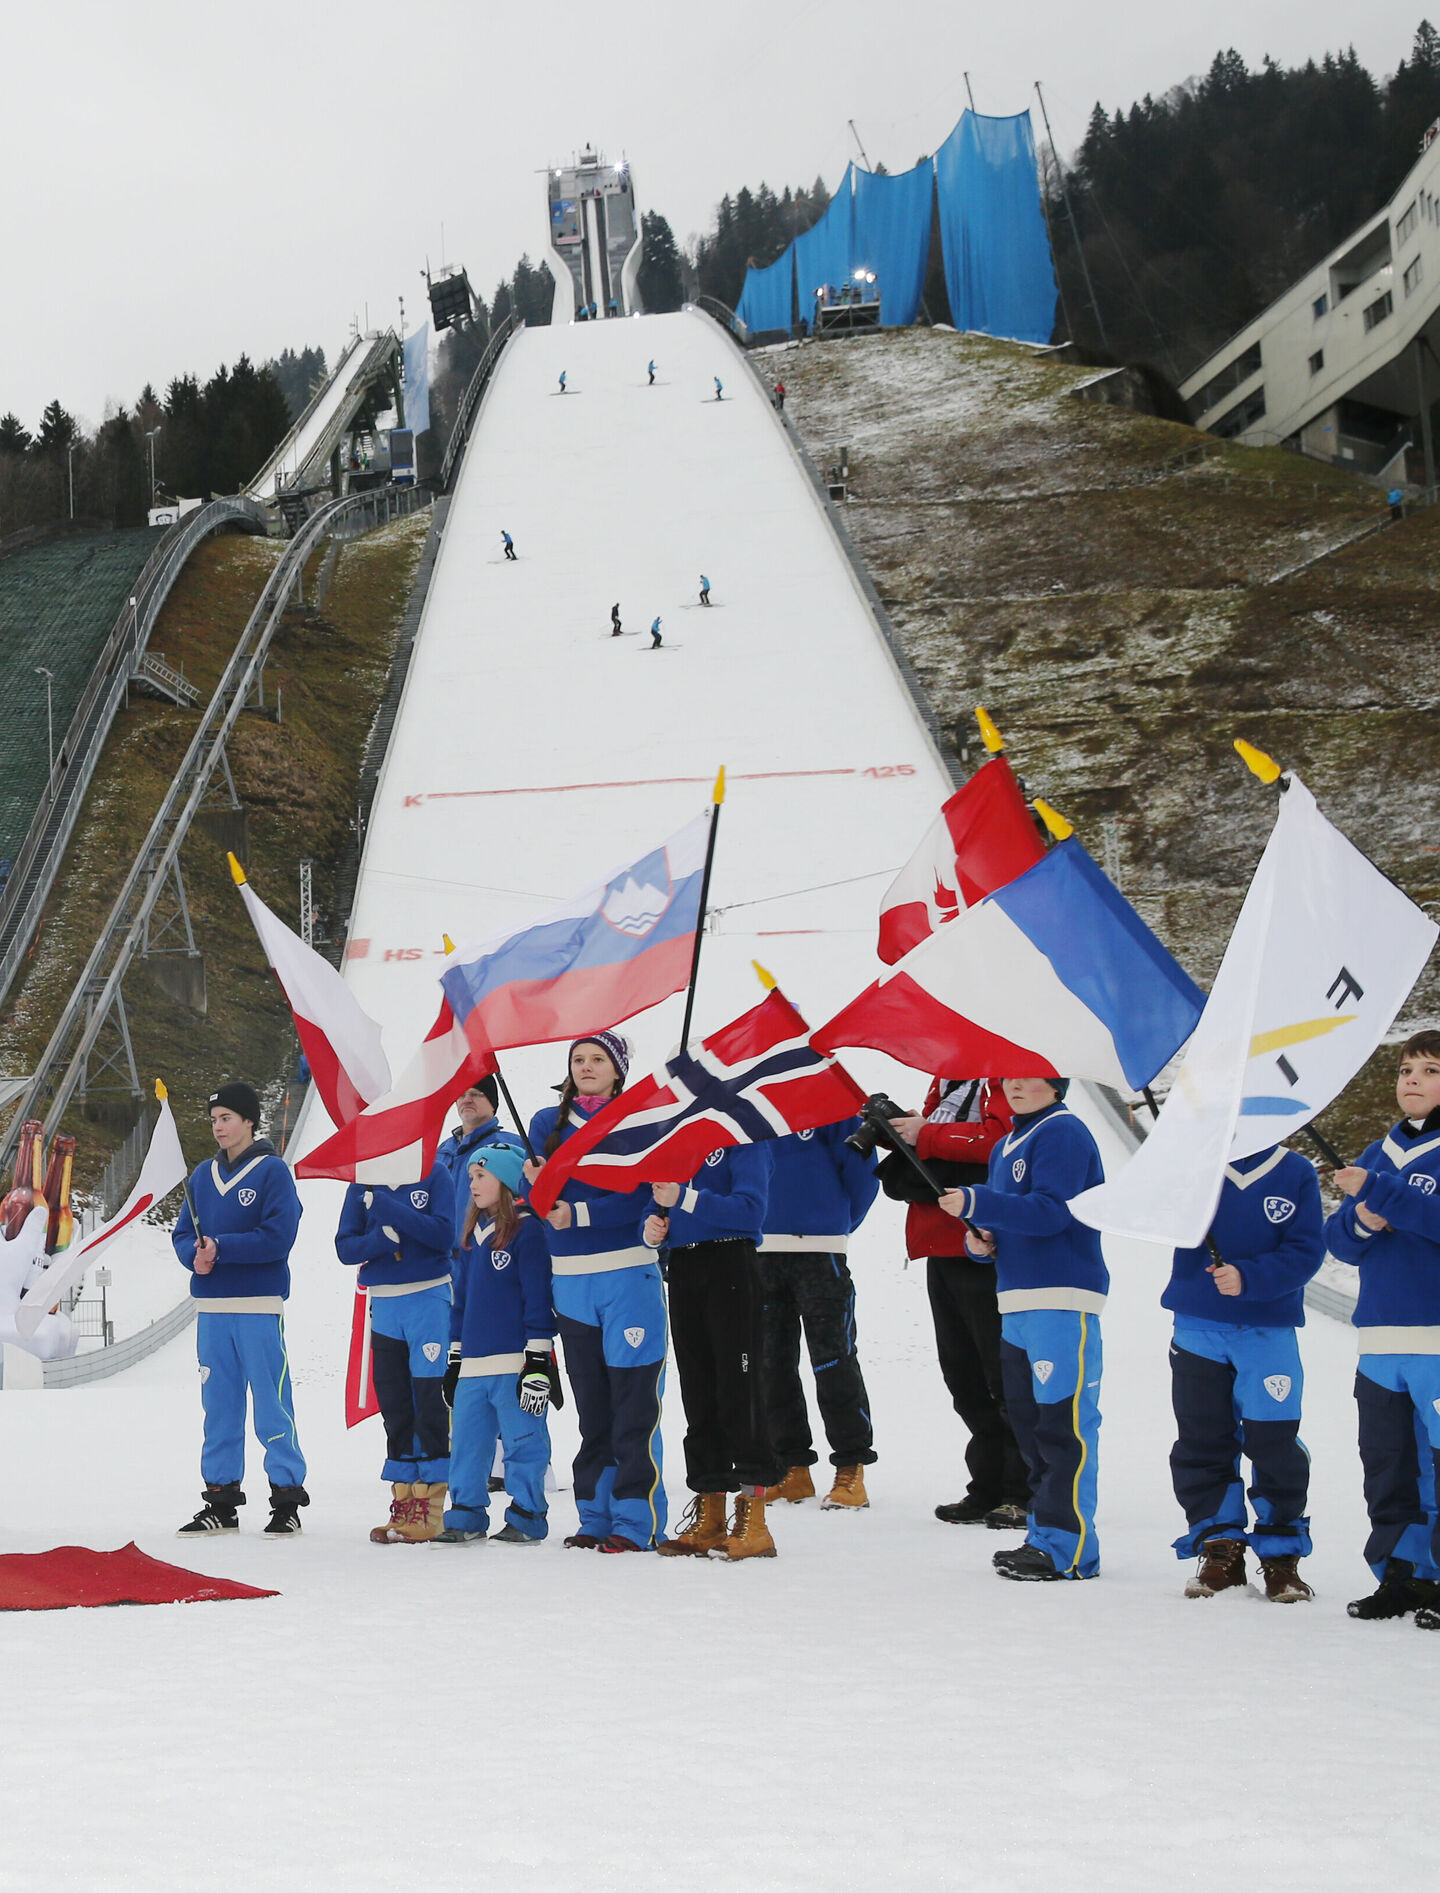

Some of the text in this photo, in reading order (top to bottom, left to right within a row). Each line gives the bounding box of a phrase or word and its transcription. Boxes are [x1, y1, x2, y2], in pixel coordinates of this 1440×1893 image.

[865, 763, 917, 779] 125
[403, 793, 422, 808] K
[383, 947, 423, 961] HS
